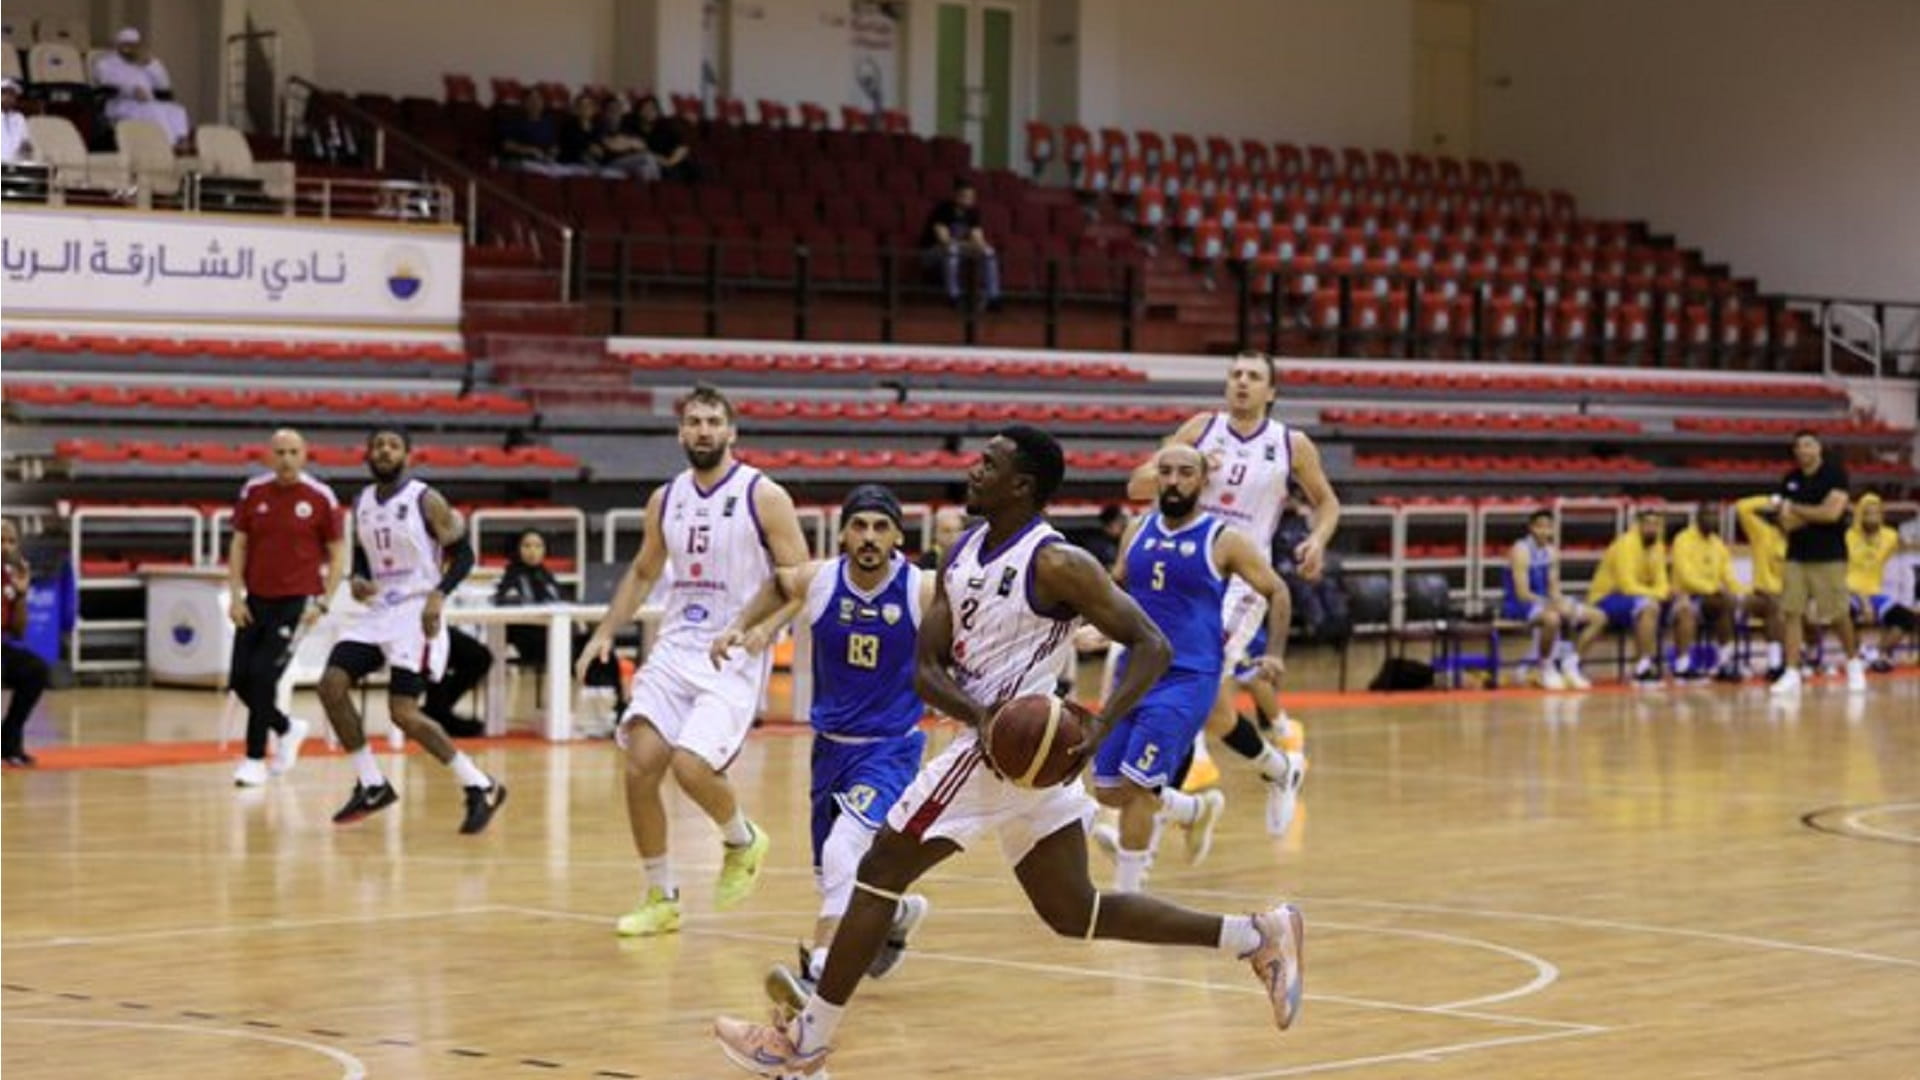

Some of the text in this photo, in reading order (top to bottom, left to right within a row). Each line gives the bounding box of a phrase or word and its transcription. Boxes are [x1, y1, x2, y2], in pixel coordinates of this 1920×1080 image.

[261, 250, 347, 301] نادي
[1227, 463, 1247, 487] 9
[687, 525, 710, 554] 15
[1151, 561, 1166, 591] 5
[960, 597, 979, 631] 2
[848, 633, 879, 669] 83
[1136, 742, 1159, 771] 5
